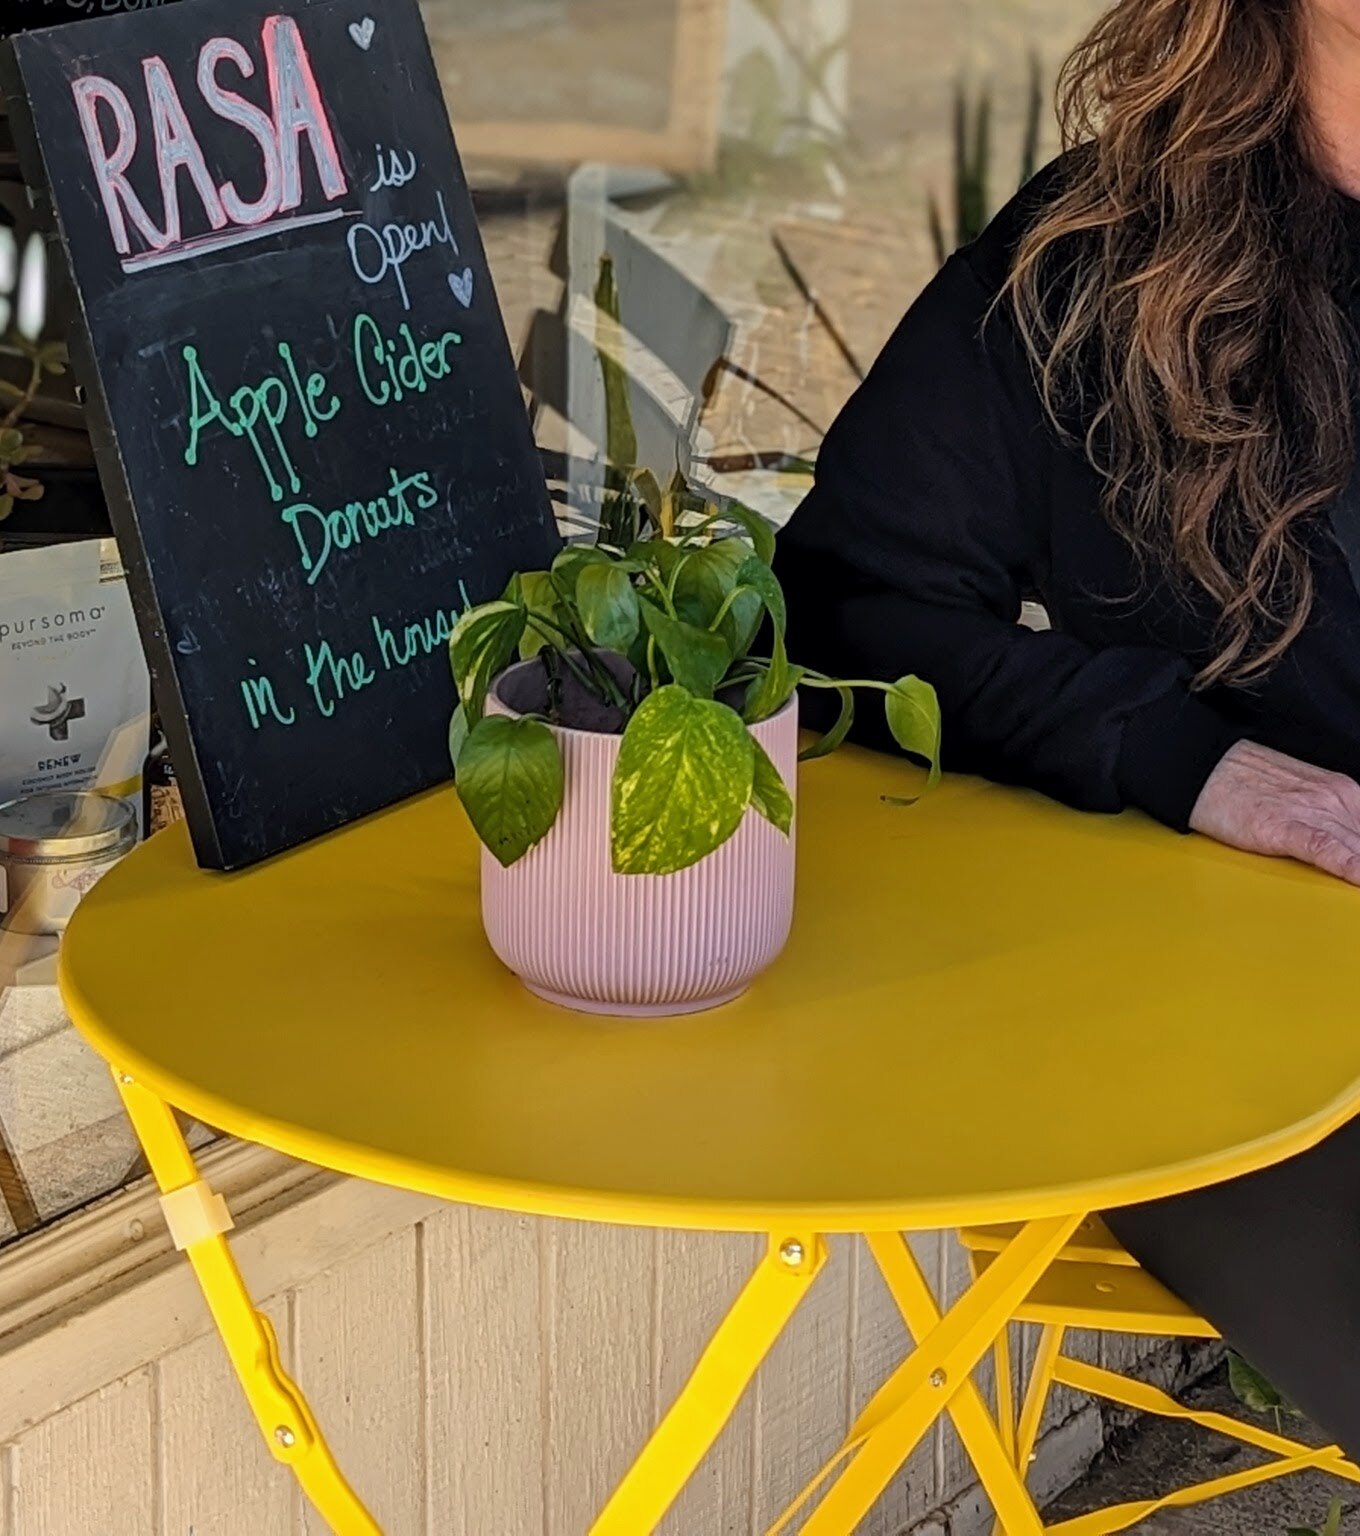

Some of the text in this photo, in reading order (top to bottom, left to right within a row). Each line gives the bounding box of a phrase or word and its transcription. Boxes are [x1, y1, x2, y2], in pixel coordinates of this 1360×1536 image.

[70, 13, 349, 255] RASA
[369, 143, 418, 193] is
[182, 313, 462, 502] Apple Cider
[280, 466, 439, 585] Donuts
[240, 658, 296, 729] in
[303, 639, 376, 717] the
